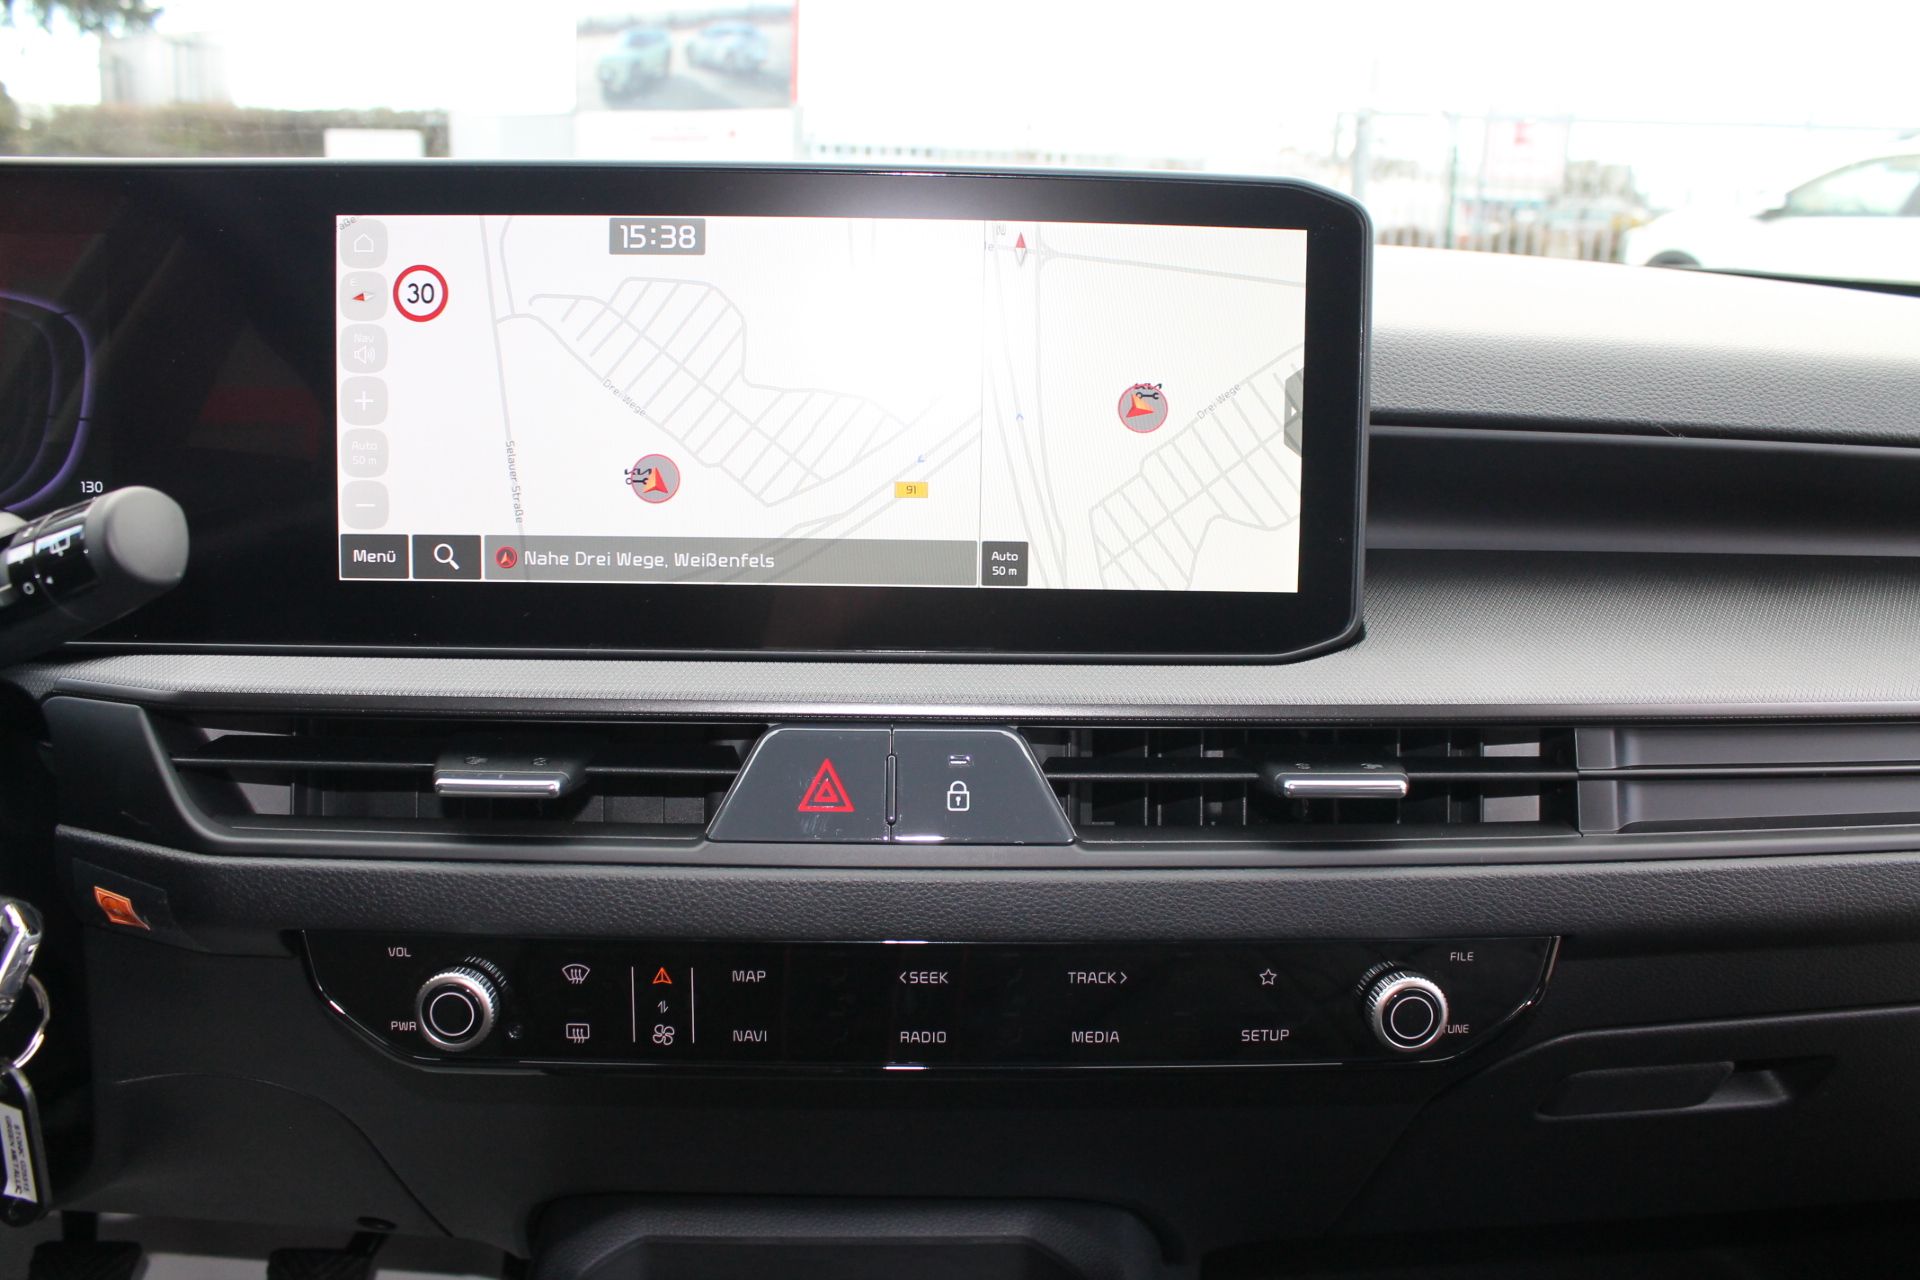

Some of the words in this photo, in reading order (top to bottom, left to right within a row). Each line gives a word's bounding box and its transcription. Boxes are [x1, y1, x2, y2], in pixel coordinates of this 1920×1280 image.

[620, 224, 696, 249] 15:38
[407, 282, 435, 304] 30
[353, 333, 375, 343] Nav
[603, 378, 624, 398] Drei
[622, 394, 647, 417] Wege
[1196, 402, 1218, 420] Drei
[1215, 383, 1241, 404] Wege
[351, 440, 378, 451] Auto
[352, 455, 366, 465] 50
[368, 457, 377, 465] m
[505, 440, 518, 483] Selauer
[80, 481, 104, 493] 130
[906, 485, 917, 495] 91
[511, 485, 524, 524] Straße
[353, 549, 396, 563] Menü
[524, 550, 569, 566] Nahe
[575, 551, 611, 566] Drei
[616, 551, 668, 569] Wege,
[674, 552, 775, 568] Weißenfels
[991, 551, 1019, 562] Auto
[992, 565, 1006, 576] 50
[1008, 568, 1017, 576] m
[387, 946, 412, 958] VOL
[1450, 951, 1474, 962] FILE
[732, 970, 766, 983] MAP
[390, 1020, 417, 1031] PWR
[733, 1030, 767, 1042] NAVI
[900, 1031, 947, 1044] RADIO
[1071, 1030, 1120, 1043] MEDIA
[1241, 1029, 1290, 1042] SETUP
